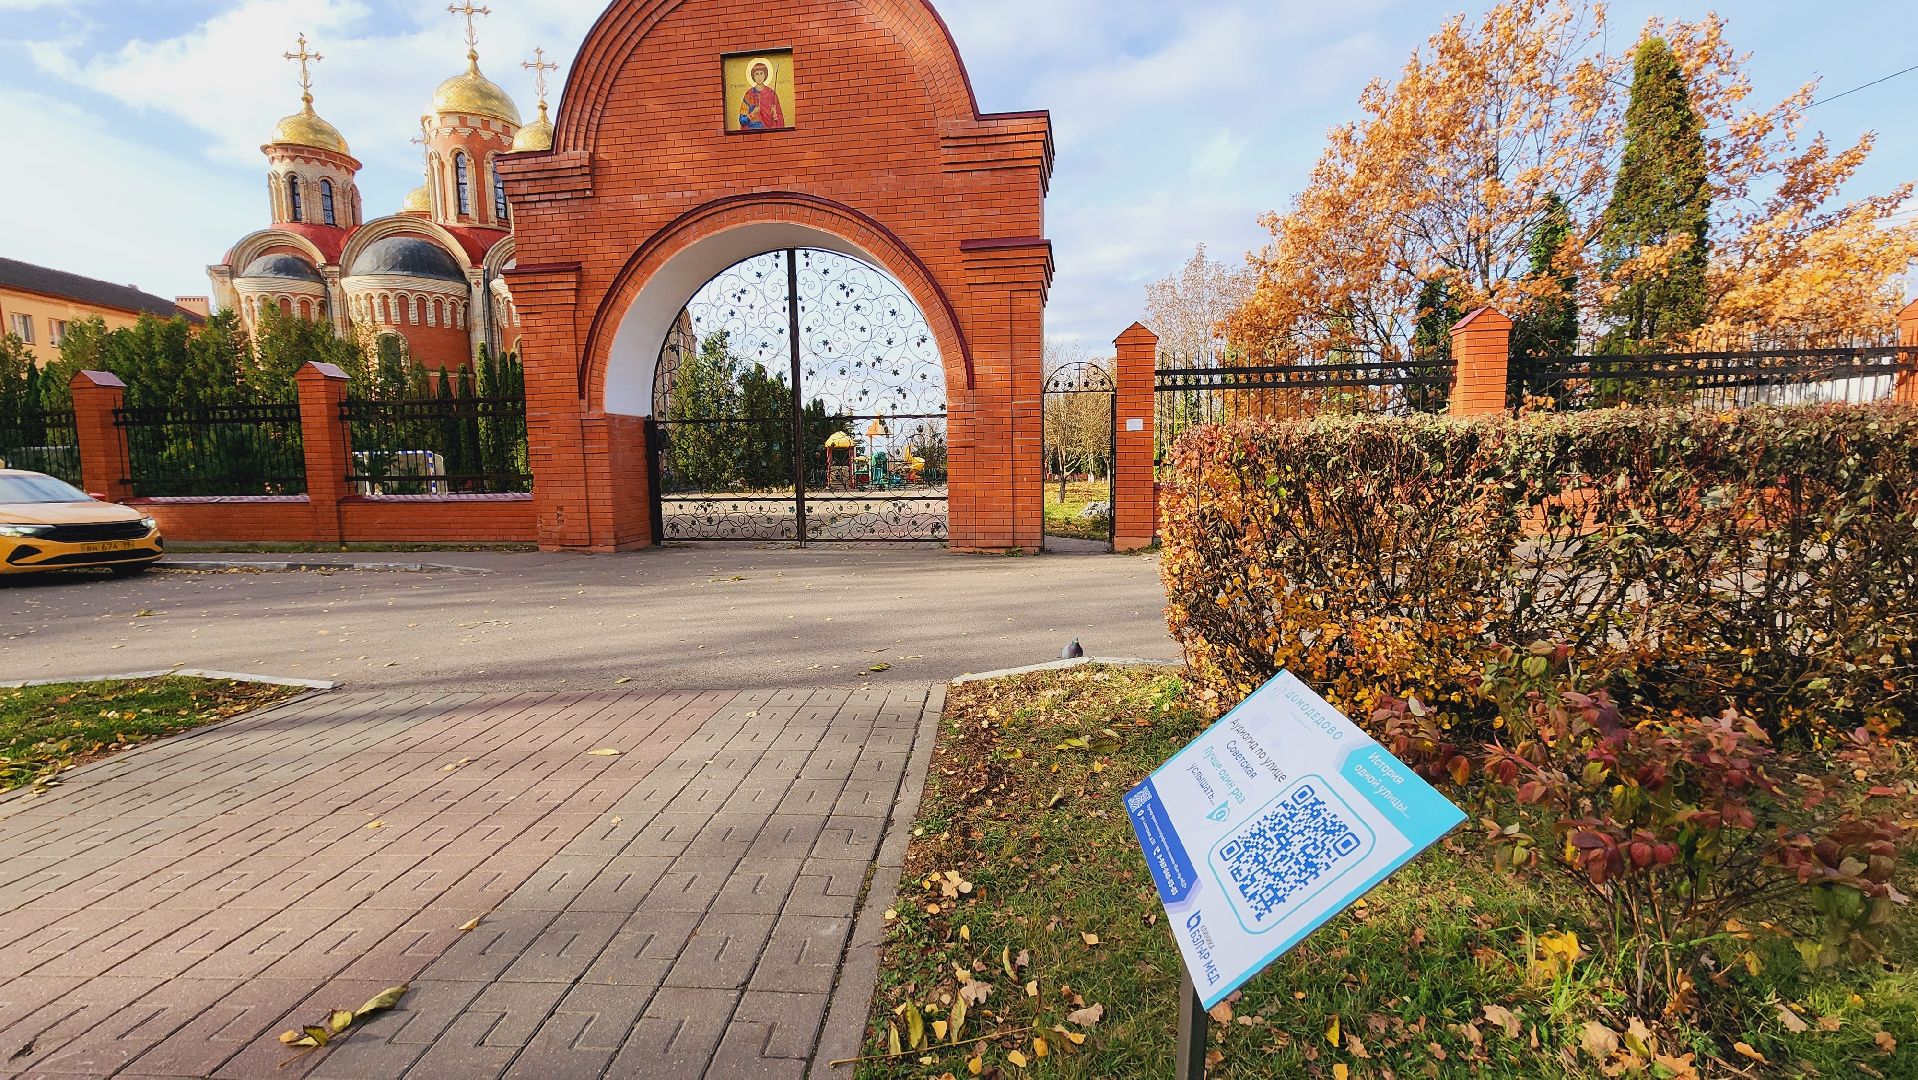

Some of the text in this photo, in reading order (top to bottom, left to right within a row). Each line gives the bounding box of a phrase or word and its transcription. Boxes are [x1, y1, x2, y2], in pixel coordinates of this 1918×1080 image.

[1285, 690, 1343, 740] ДОМОДЕДОВО
[1226, 740, 1258, 779] Советская
[1230, 718, 1287, 783] Аудиогид по улице
[1368, 752, 1404, 785] История
[1203, 745, 1246, 804] Лучше один раз
[1355, 764, 1381, 789] одной
[1200, 925, 1215, 949] КЛИНИКА
[1203, 959, 1220, 986] МЕД
